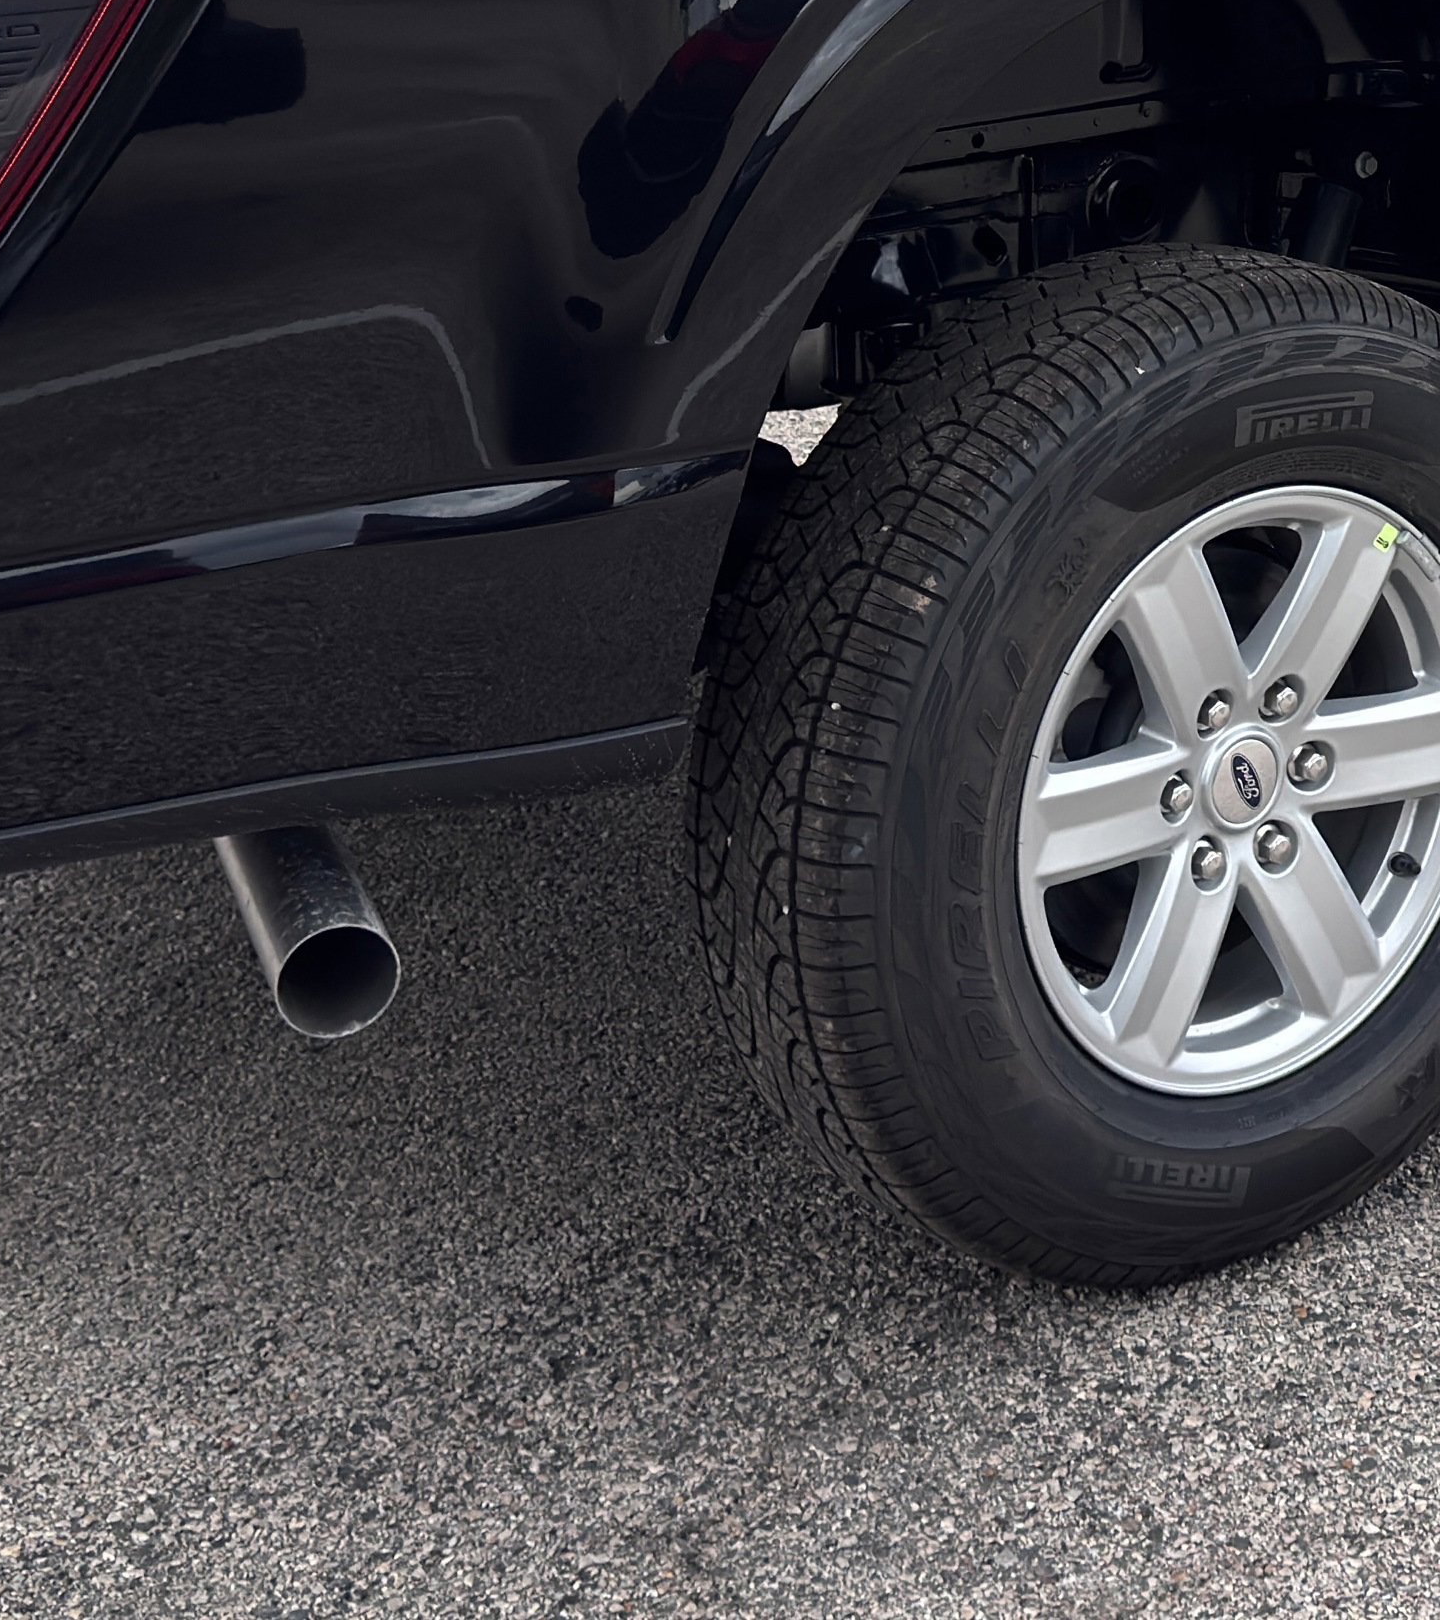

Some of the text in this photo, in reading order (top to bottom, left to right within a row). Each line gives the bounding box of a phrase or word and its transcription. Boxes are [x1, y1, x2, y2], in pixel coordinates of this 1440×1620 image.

[1234, 390, 1374, 449] PIRELLI
[1235, 762, 1260, 799] Ford
[948, 640, 1030, 1063] PIRELLI
[1115, 1153, 1253, 1208] PIRELLI
